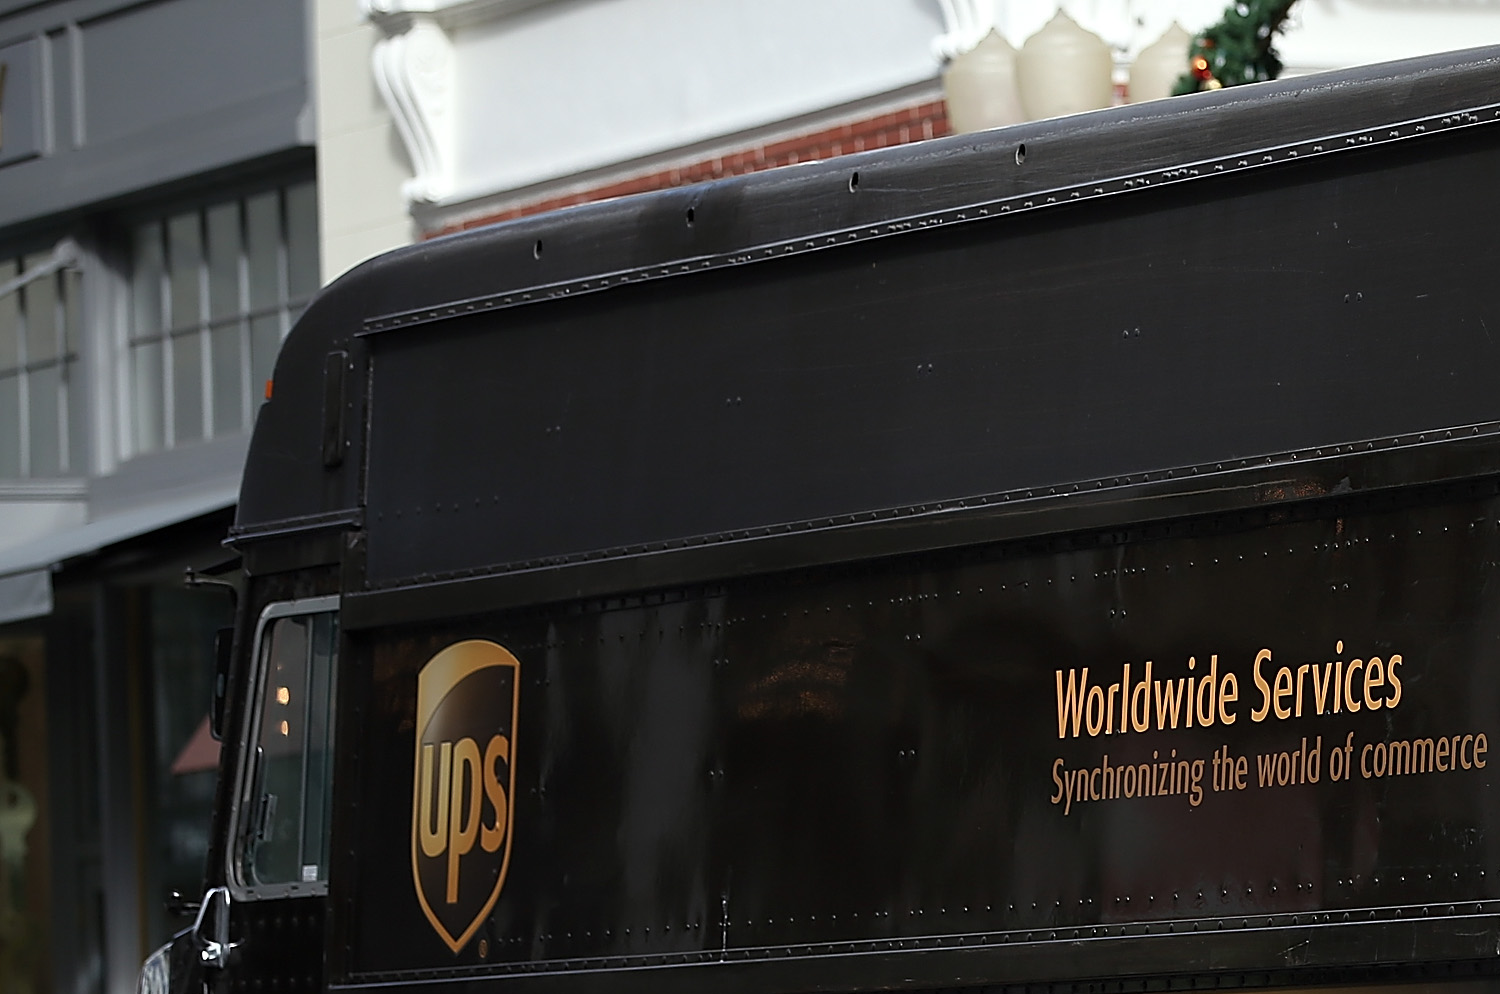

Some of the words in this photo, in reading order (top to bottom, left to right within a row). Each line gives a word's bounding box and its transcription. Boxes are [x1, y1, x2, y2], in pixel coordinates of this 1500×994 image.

[1056, 655, 1238, 739] Worldwide
[1251, 640, 1402, 723] Services
[1051, 749, 1205, 816] Synchronizing
[1212, 745, 1248, 791] the
[1257, 735, 1321, 788] world
[1330, 732, 1354, 782] of
[1361, 732, 1488, 779] commerce
